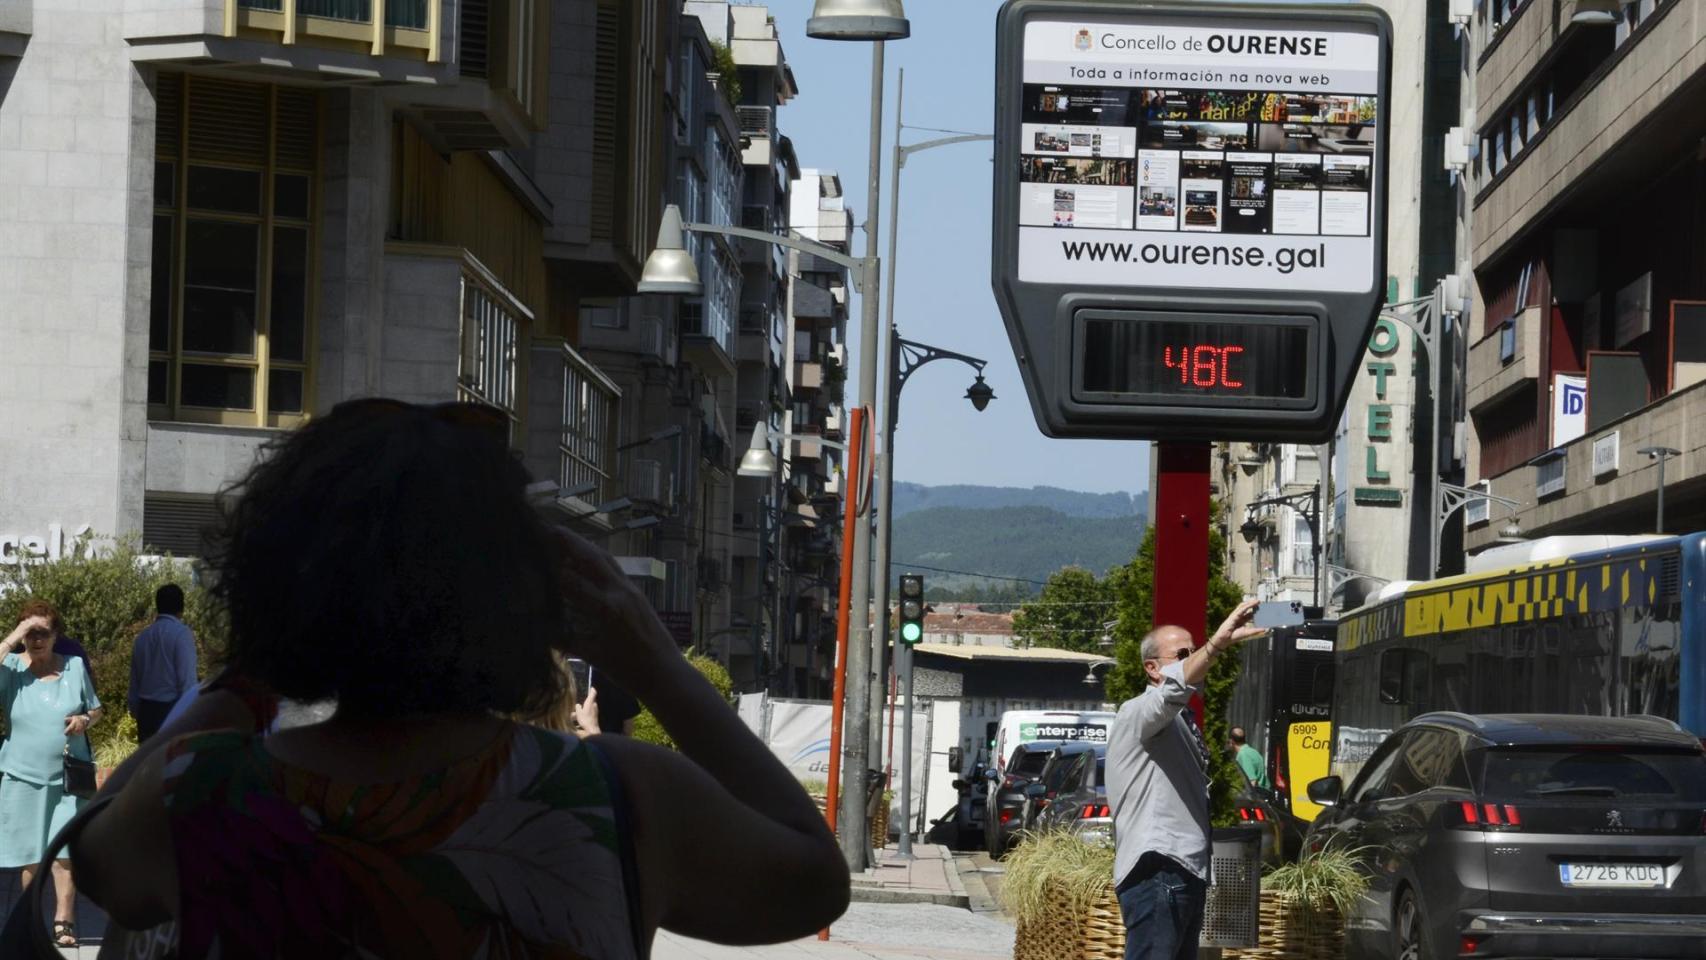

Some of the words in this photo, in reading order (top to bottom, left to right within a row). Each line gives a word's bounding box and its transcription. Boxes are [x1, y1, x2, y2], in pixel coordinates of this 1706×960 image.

[1101, 33, 1177, 51] Concello
[1182, 36, 1203, 52] de
[1207, 34, 1328, 57] OURENSE
[1069, 66, 1106, 79] Toda
[1113, 70, 1123, 79] a
[1129, 68, 1223, 83] información
[1229, 73, 1249, 83] na
[1255, 74, 1292, 84] nova
[1299, 73, 1330, 86] web
[1062, 240, 1325, 274] www.ourense.gal
[1022, 725, 1106, 739] enterprise
[1293, 724, 1318, 735] 6909
[1574, 864, 1618, 881] 2726
[1624, 865, 1659, 881] KDC
